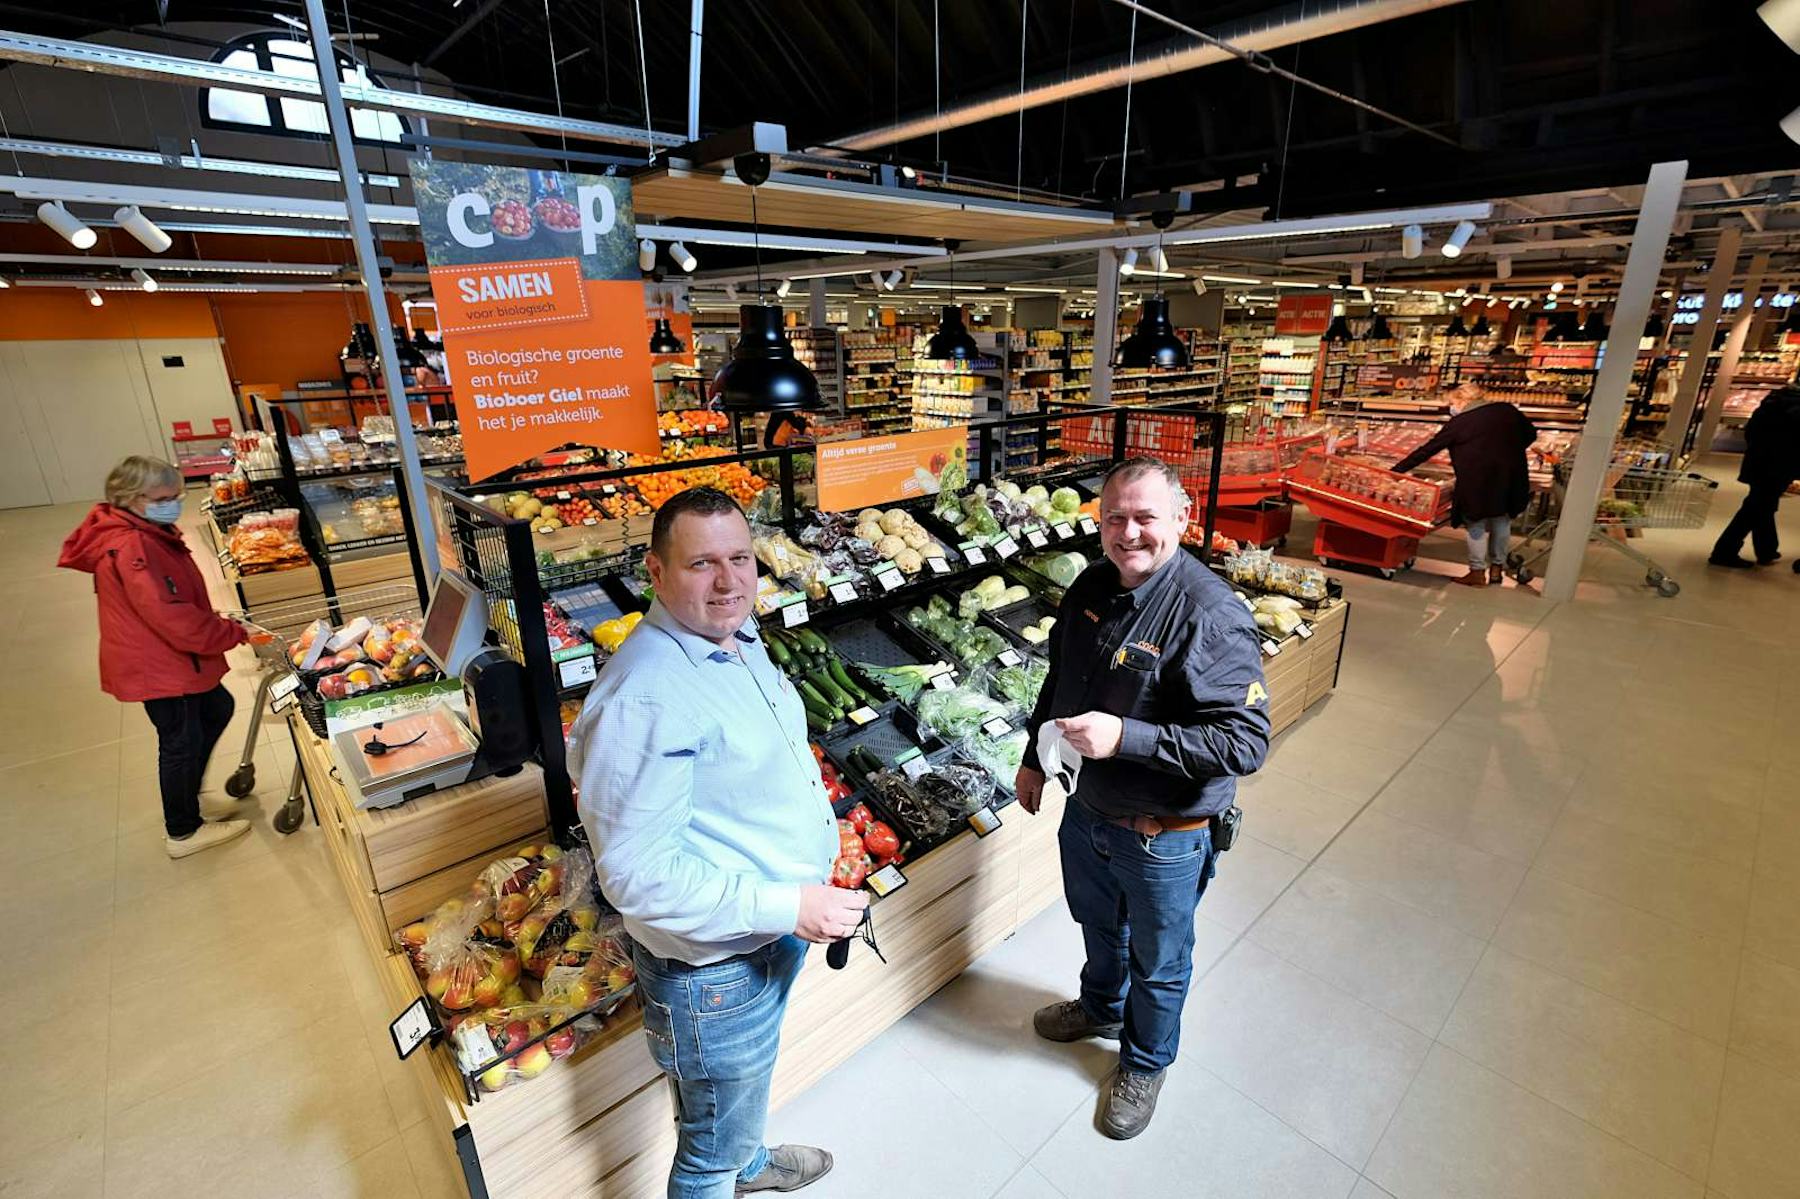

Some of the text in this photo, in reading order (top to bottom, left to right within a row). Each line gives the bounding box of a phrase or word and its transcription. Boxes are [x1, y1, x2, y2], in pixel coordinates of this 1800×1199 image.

[457, 271, 553, 304] SAMEN
[466, 301, 556, 321] voor biologisch
[466, 346, 624, 367] Biologische groente
[471, 370, 539, 388] en fruit?
[474, 384, 631, 410] Bioboer Giel maakt
[478, 407, 604, 432] het je makkelijk.
[821, 445, 846, 460] Altijd
